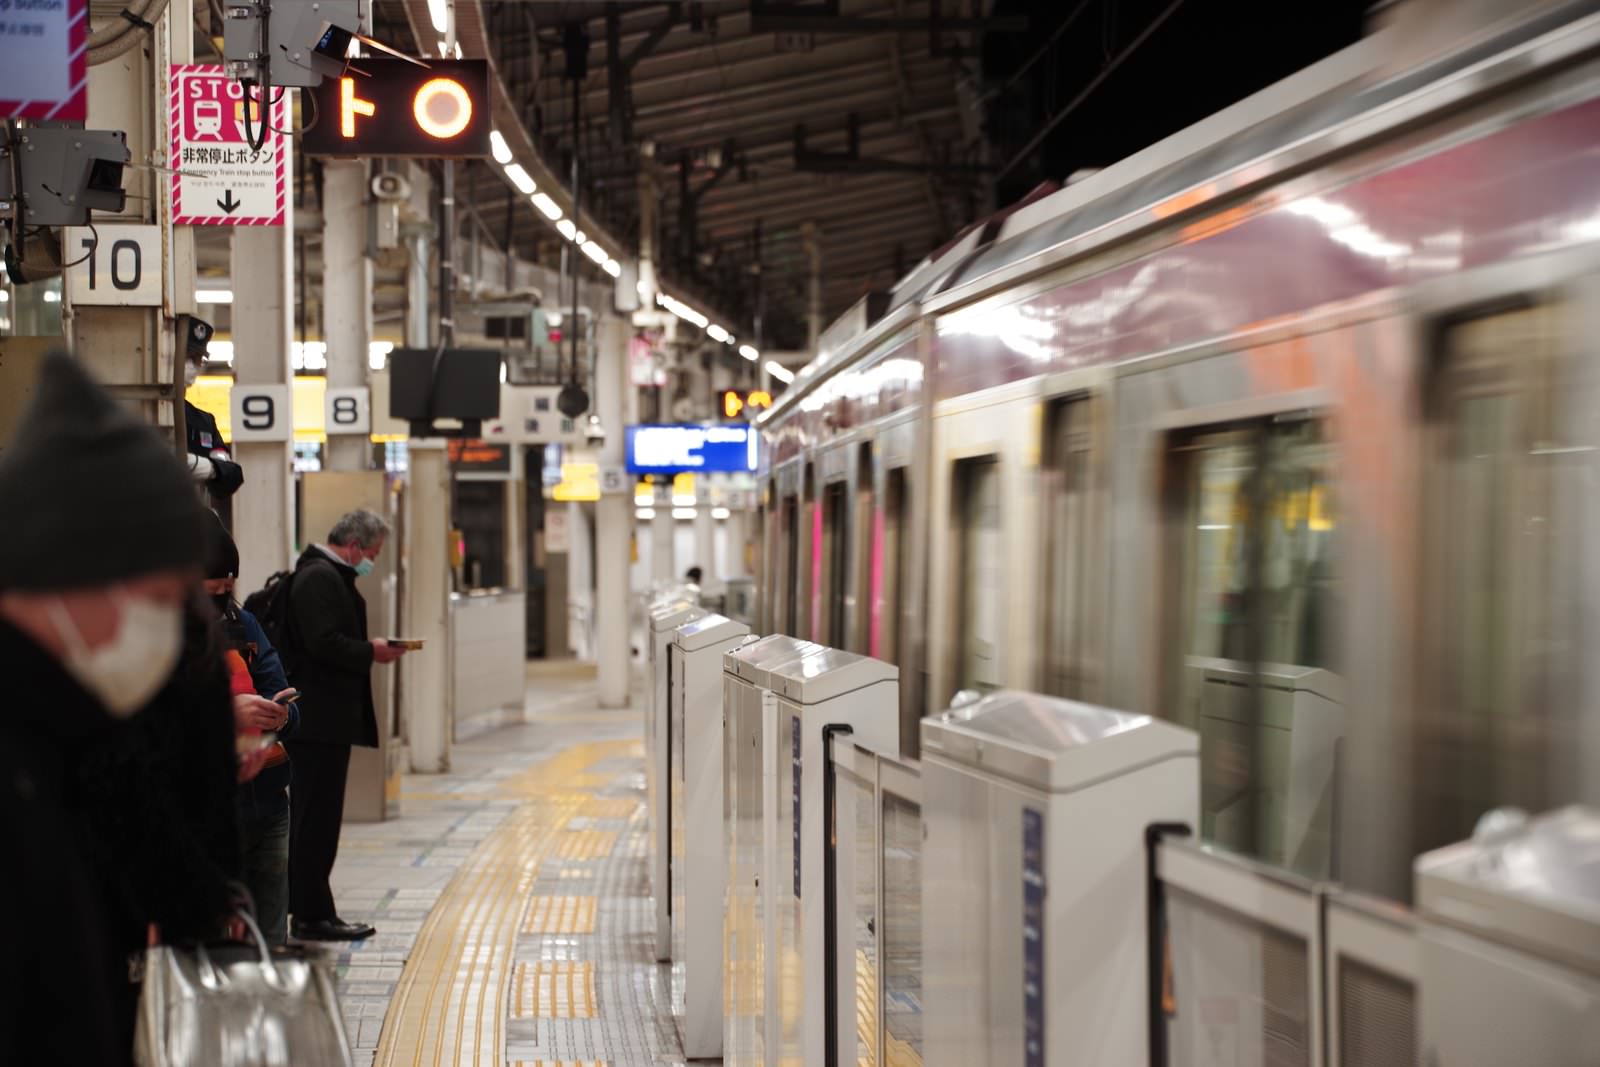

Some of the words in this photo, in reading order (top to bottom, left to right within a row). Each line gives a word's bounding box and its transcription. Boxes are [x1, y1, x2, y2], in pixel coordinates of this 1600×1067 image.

[183, 147, 274, 164] 非常停止ボタン
[236, 169, 250, 178] stop
[82, 239, 142, 290] 10
[242, 395, 275, 430] 9
[333, 397, 358, 424] 8
